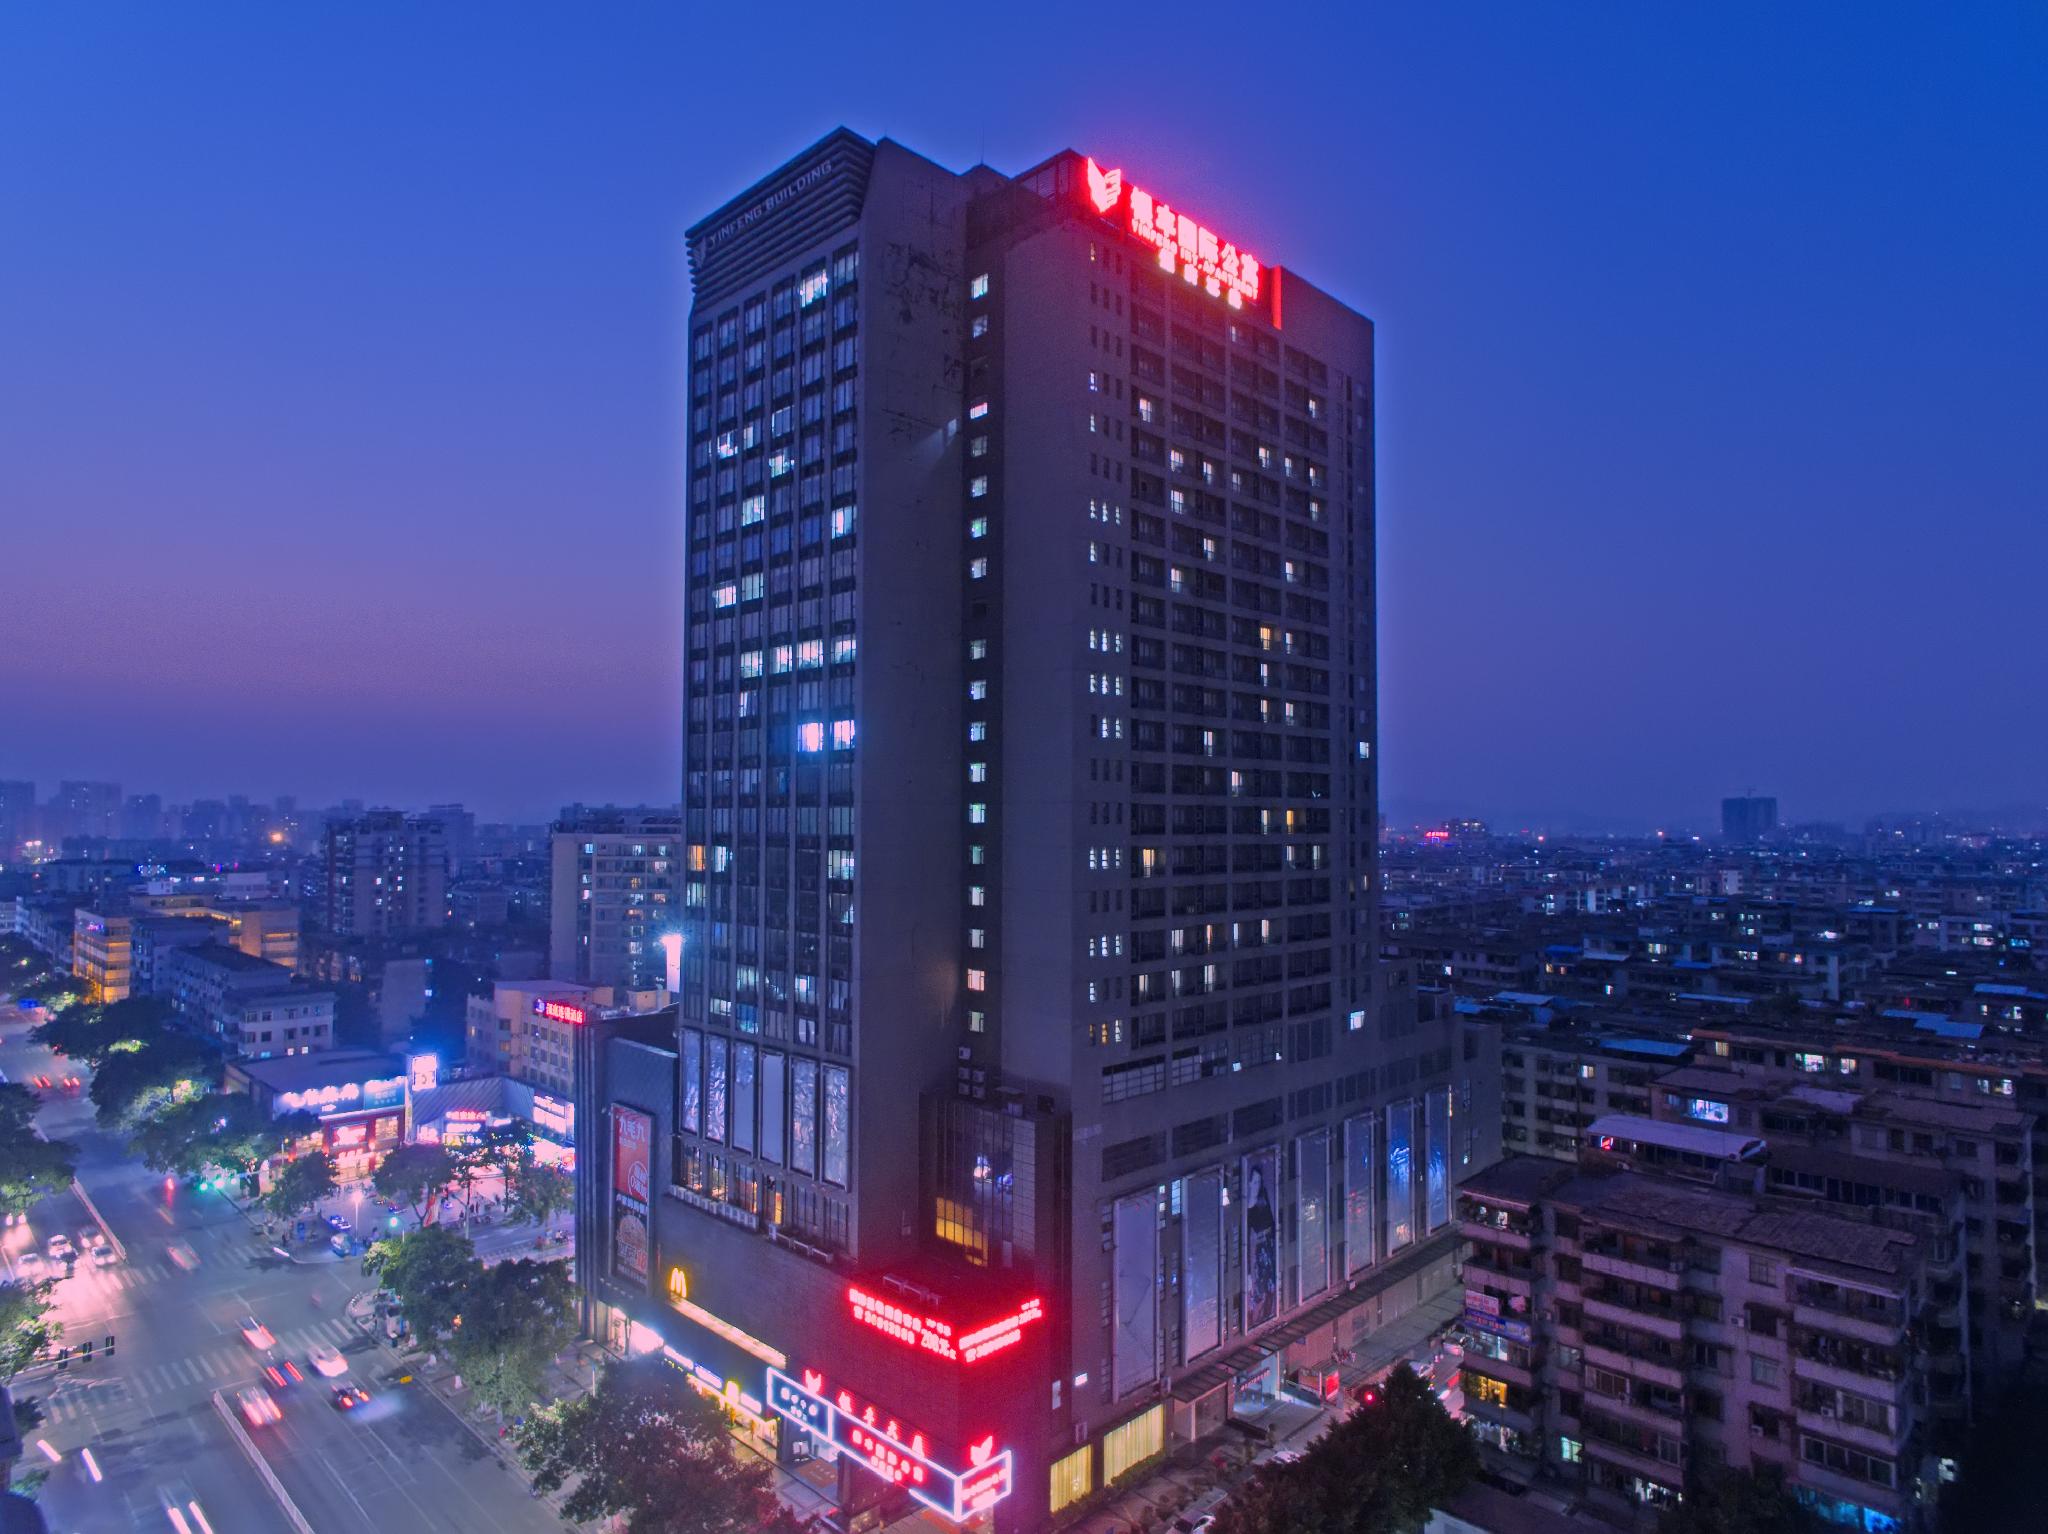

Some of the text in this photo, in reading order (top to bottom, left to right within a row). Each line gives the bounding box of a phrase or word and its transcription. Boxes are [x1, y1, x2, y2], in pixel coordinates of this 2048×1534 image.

[707, 159, 833, 250] YINFENG BUILDING
[619, 1115, 645, 1142] 九毛九
